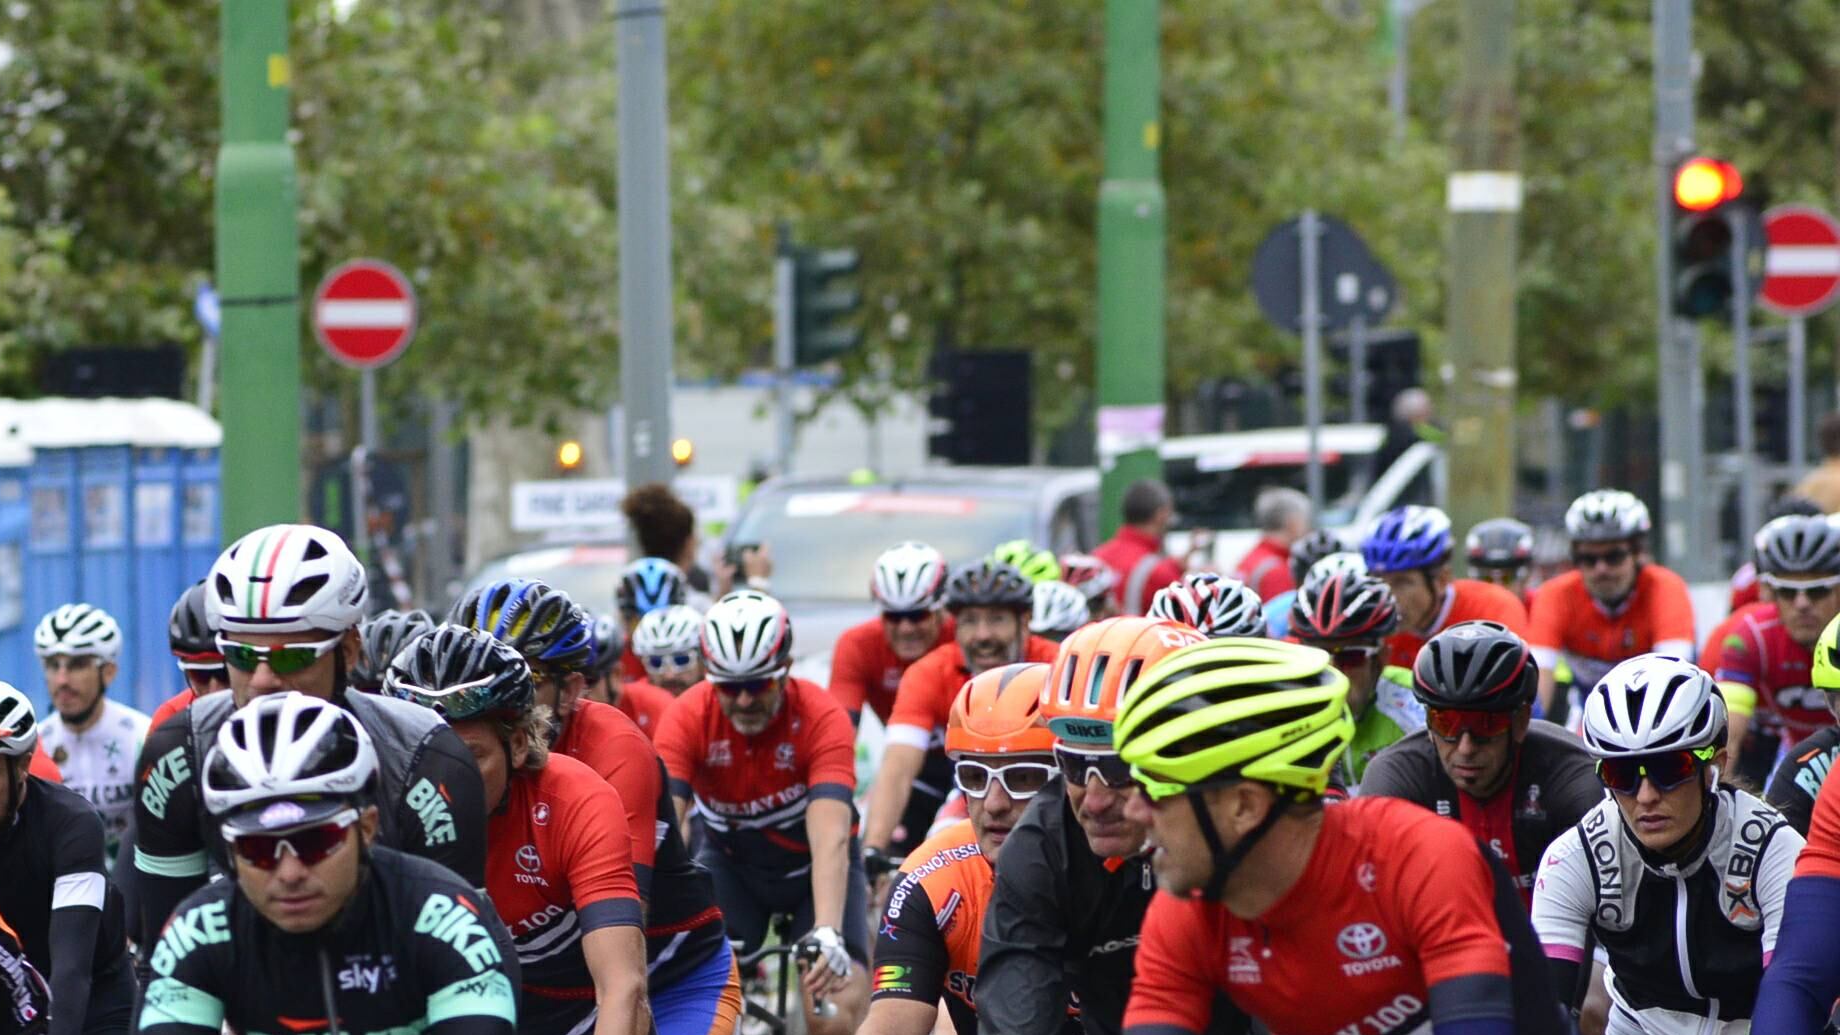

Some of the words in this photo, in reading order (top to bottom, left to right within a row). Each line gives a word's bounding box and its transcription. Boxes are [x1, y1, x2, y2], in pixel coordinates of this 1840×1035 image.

[1065, 722, 1107, 738] BIKE
[140, 746, 193, 820] BIKE
[405, 777, 458, 848] BIKE
[149, 901, 232, 978] BIKE
[413, 893, 502, 974] BIKE
[338, 962, 380, 994] sky
[1342, 955, 1401, 977] TOYOTA
[1364, 993, 1423, 1034] 100
